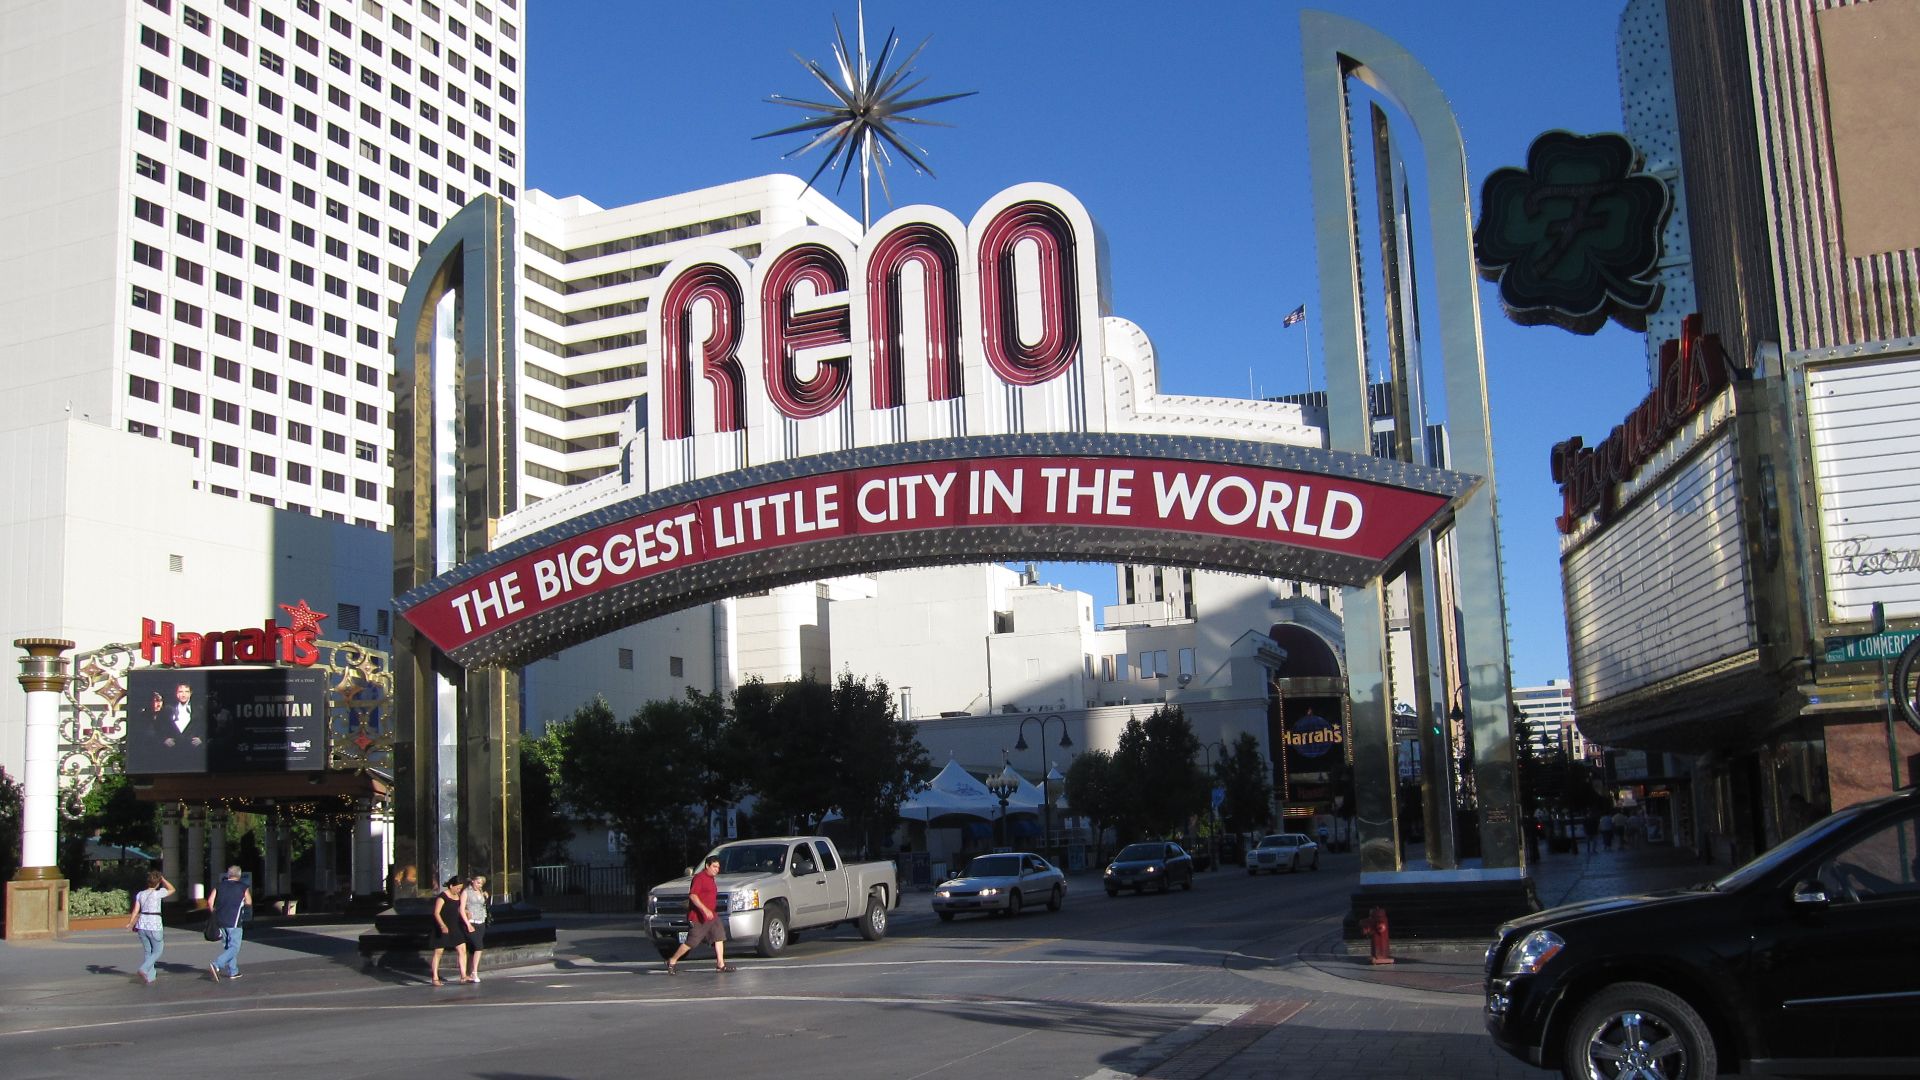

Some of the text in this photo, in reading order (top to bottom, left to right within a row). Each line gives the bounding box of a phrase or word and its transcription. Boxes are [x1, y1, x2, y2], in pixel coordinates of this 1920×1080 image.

[661, 199, 1083, 441] RENO
[451, 468, 1364, 634] THE BIGGEST LITTLE CITY IN THE WORLD
[1846, 633, 1920, 657] W COMMERCI
[236, 703, 312, 718] ICONMAN
